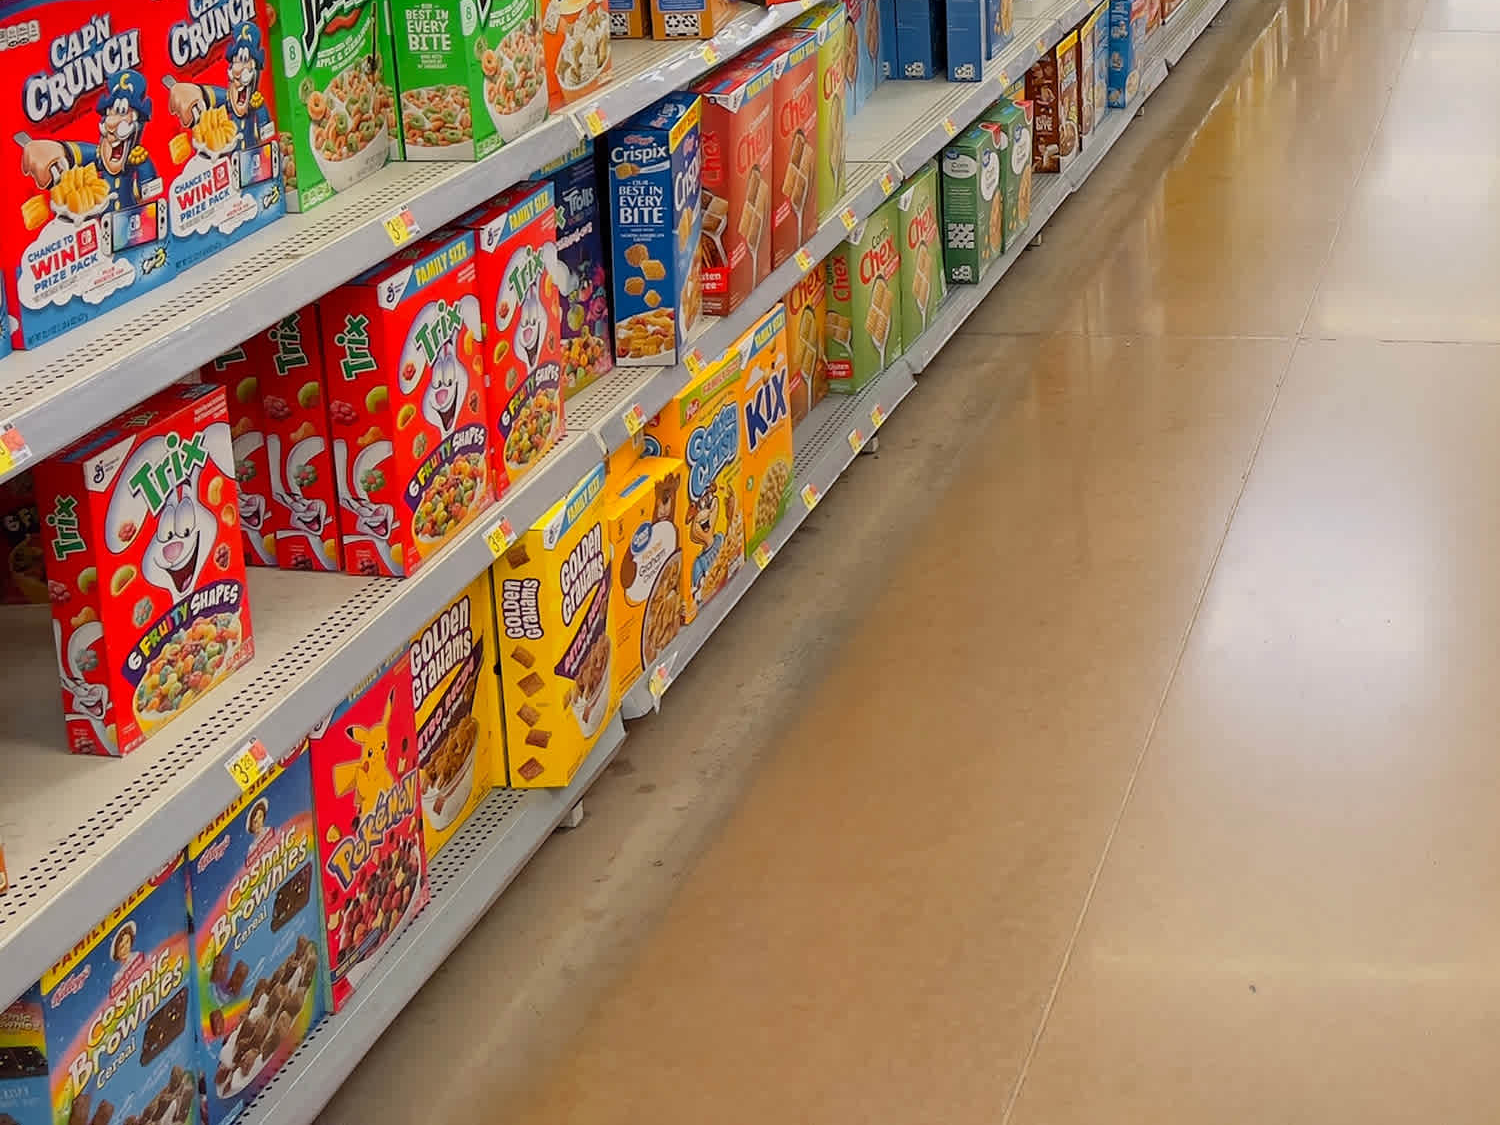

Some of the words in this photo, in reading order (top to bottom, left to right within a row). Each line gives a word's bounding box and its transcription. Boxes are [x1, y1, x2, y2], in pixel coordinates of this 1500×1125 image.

[405, 9, 434, 20] BEST
[436, 10, 448, 20] IN
[407, 20, 448, 33] EVERY
[51, 14, 111, 68] CAP'N
[409, 34, 451, 51] BITE
[27, 29, 140, 121] CRUNCH
[611, 144, 667, 165] Crispix
[176, 184, 214, 210] WIN
[180, 202, 208, 222] PRIZE
[208, 189, 231, 209] PACK
[618, 185, 646, 196] BEST
[648, 186, 663, 195] IN
[619, 195, 663, 208] EVERY
[619, 207, 664, 225] BITE
[30, 245, 76, 279] WIN
[33, 271, 67, 293] PRIZE
[69, 255, 99, 277] PACK
[415, 255, 447, 287] FAMILY
[449, 242, 467, 268] SIZE
[509, 245, 544, 299] Trix
[859, 237, 898, 285] Chex
[339, 314, 378, 380] Trix
[414, 300, 462, 364] Trix
[128, 430, 210, 512] Trix
[51, 495, 78, 561] Trix
[189, 583, 239, 616] SHAPES
[227, 825, 297, 909] Cosmic
[212, 838, 308, 955] Brownies
[51, 917, 109, 976] FAMILY
[112, 885, 146, 918] SIZE
[233, 910, 267, 950] Cereal
[88, 948, 170, 1046] Cosmic
[68, 956, 184, 1098] Brownies
[97, 1039, 137, 1090] Cereal
